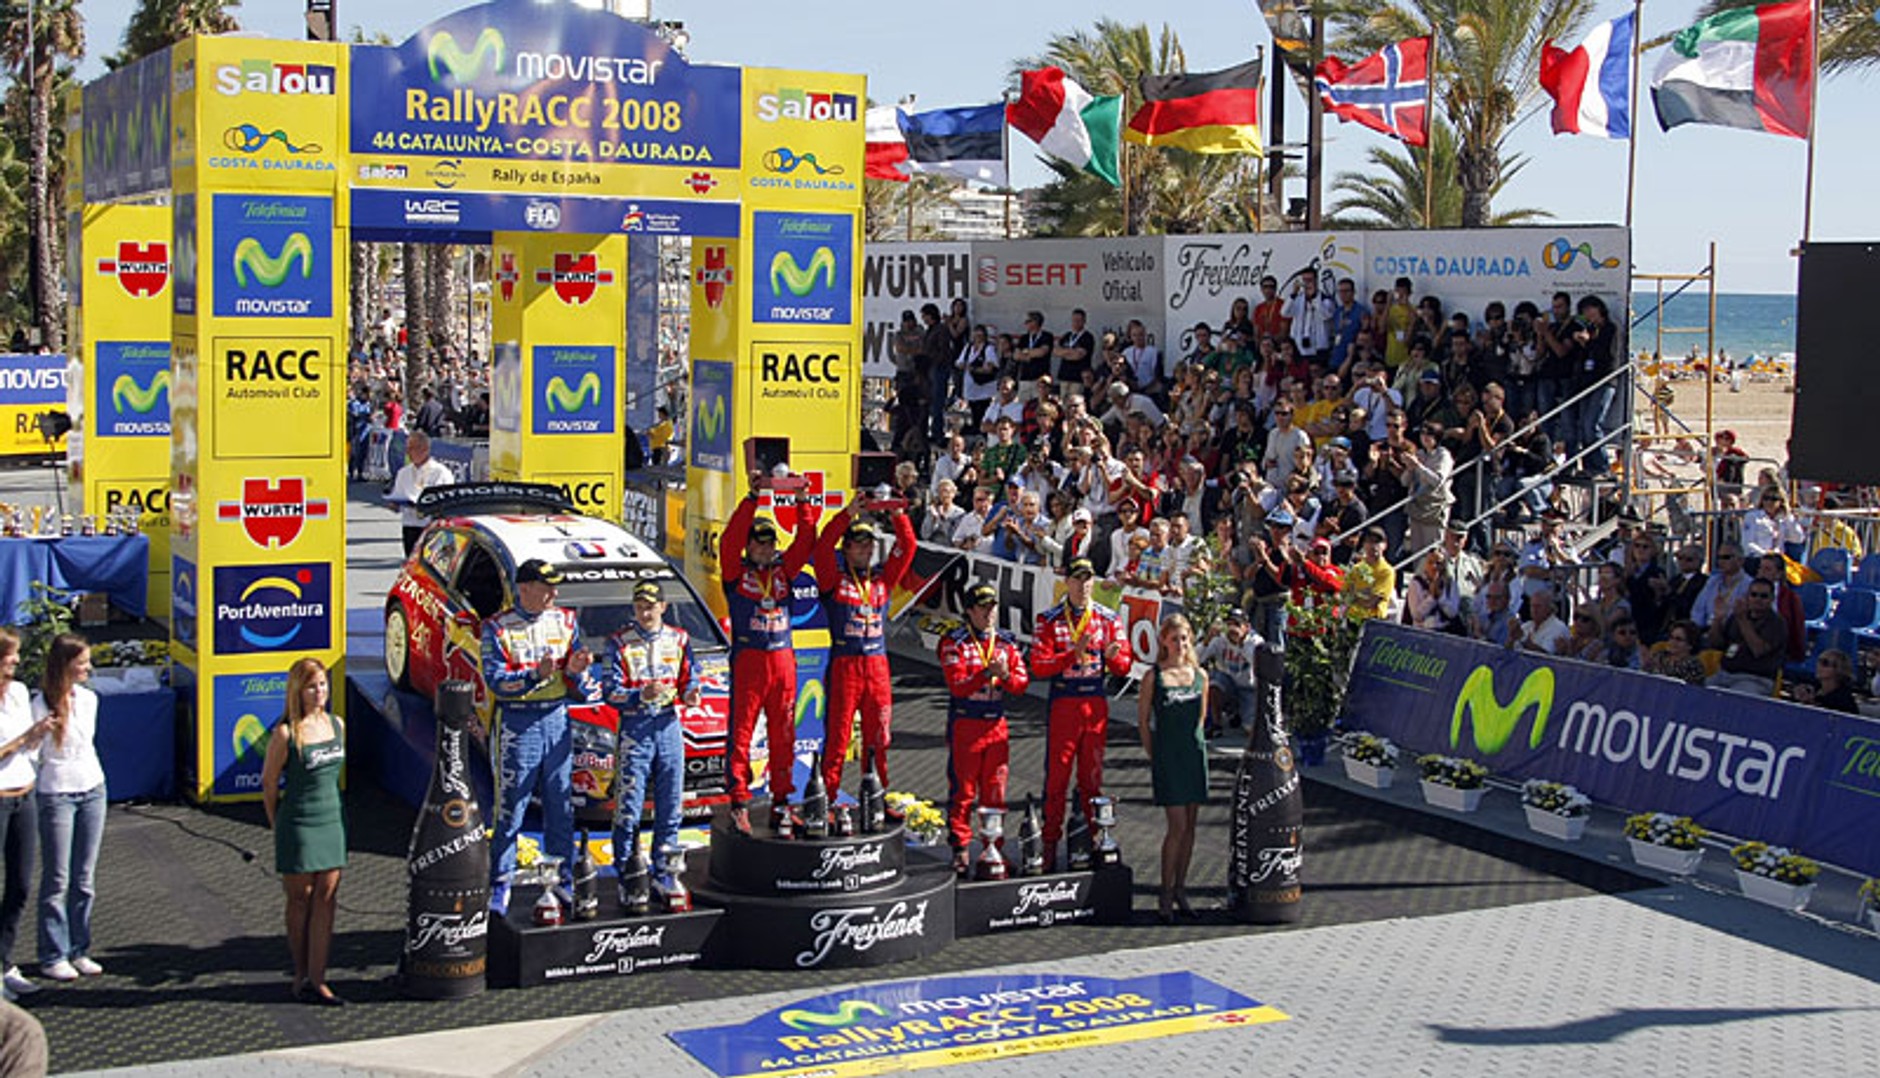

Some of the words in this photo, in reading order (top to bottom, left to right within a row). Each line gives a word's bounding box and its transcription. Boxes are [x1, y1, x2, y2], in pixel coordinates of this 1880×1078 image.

[215, 64, 331, 97] Salou
[516, 51, 663, 86] movistar
[405, 88, 592, 132] RallyRACC
[601, 98, 683, 133] 2008
[757, 93, 853, 123] Salou
[372, 130, 397, 150] 44
[600, 138, 714, 163] DAURADA
[208, 157, 257, 170] COSTA
[263, 158, 336, 172] DAURADA
[492, 168, 526, 185] Rally
[530, 170, 548, 183] de
[750, 177, 791, 190] COSTA
[795, 179, 856, 191] DAURADA
[404, 199, 461, 213] WRC
[527, 205, 558, 225] FIA
[1004, 263, 1089, 287] SEAT
[1169, 242, 1274, 309] Freixenet
[1373, 255, 1431, 276] COSTA
[1434, 255, 1532, 277] DAURADA
[1102, 280, 1143, 303] Oficial
[235, 298, 313, 314] movistar
[770, 306, 835, 322] movistar
[225, 349, 321, 382] RACC
[761, 353, 841, 383] RACC
[292, 386, 320, 399] Club
[547, 419, 600, 432] movistar
[561, 481, 606, 507] ACC
[217, 600, 324, 622] PortAventura
[1368, 634, 1448, 680] Telefónica
[1557, 701, 1807, 800] movistar
[796, 899, 930, 968] Freixenet
[900, 981, 1088, 1016] movistar
[776, 1007, 1036, 1053] RallyRACC
[1045, 993, 1153, 1020] 2008
